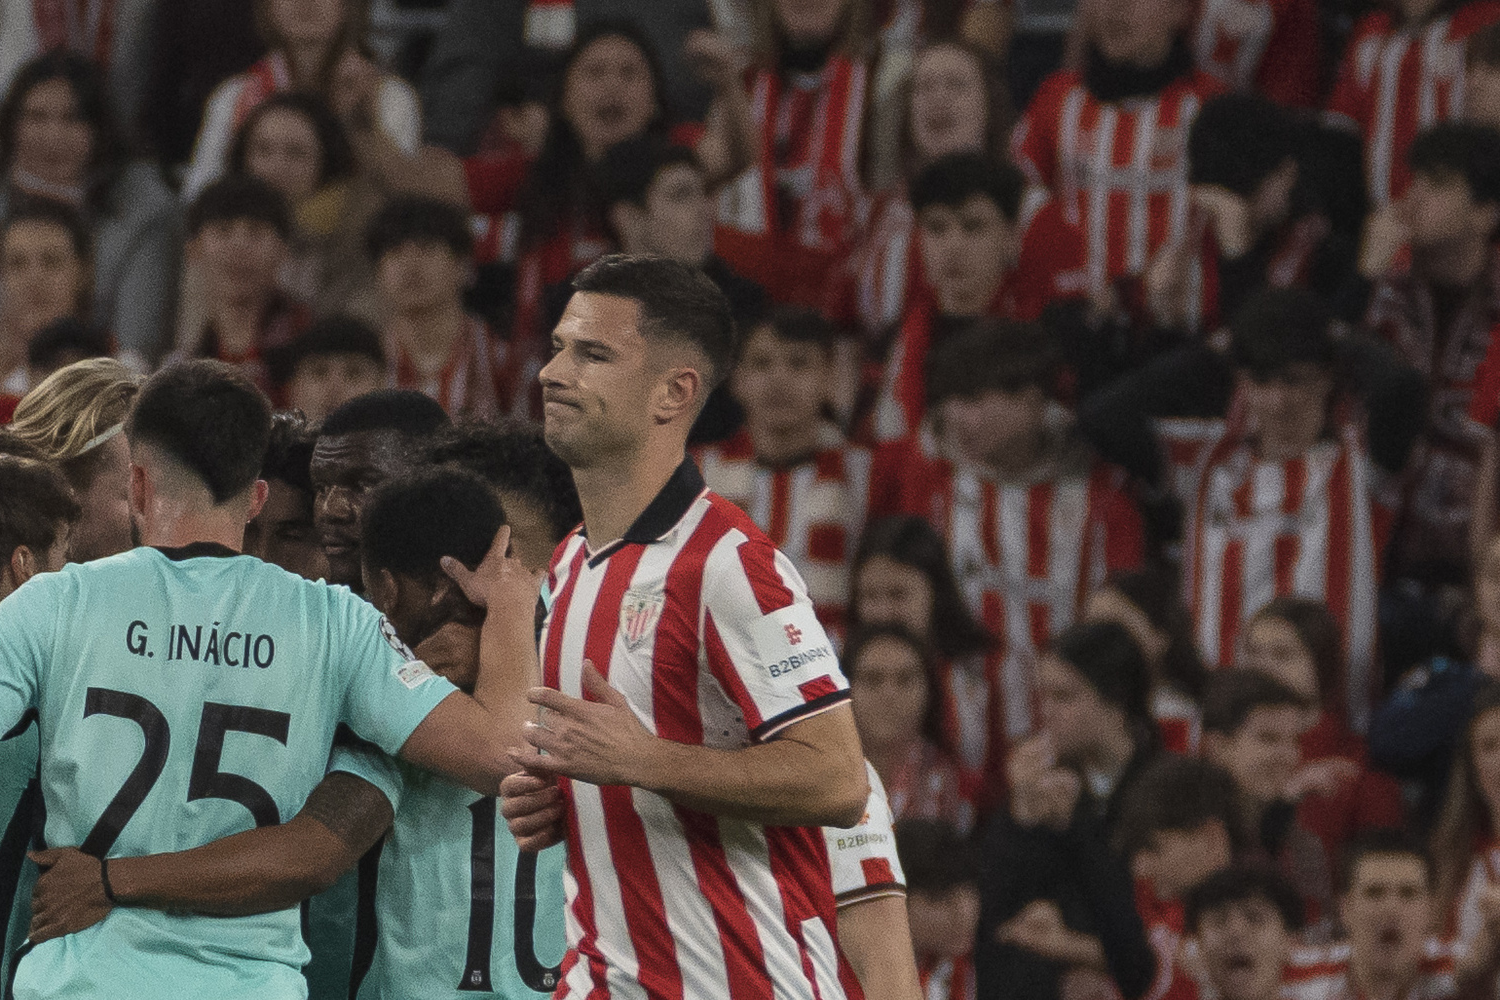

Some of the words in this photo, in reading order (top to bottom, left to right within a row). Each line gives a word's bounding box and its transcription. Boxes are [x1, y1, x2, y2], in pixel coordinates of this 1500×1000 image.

[126, 620, 154, 658] G.
[167, 621, 275, 669] INÁCIO
[76, 686, 291, 862] 25
